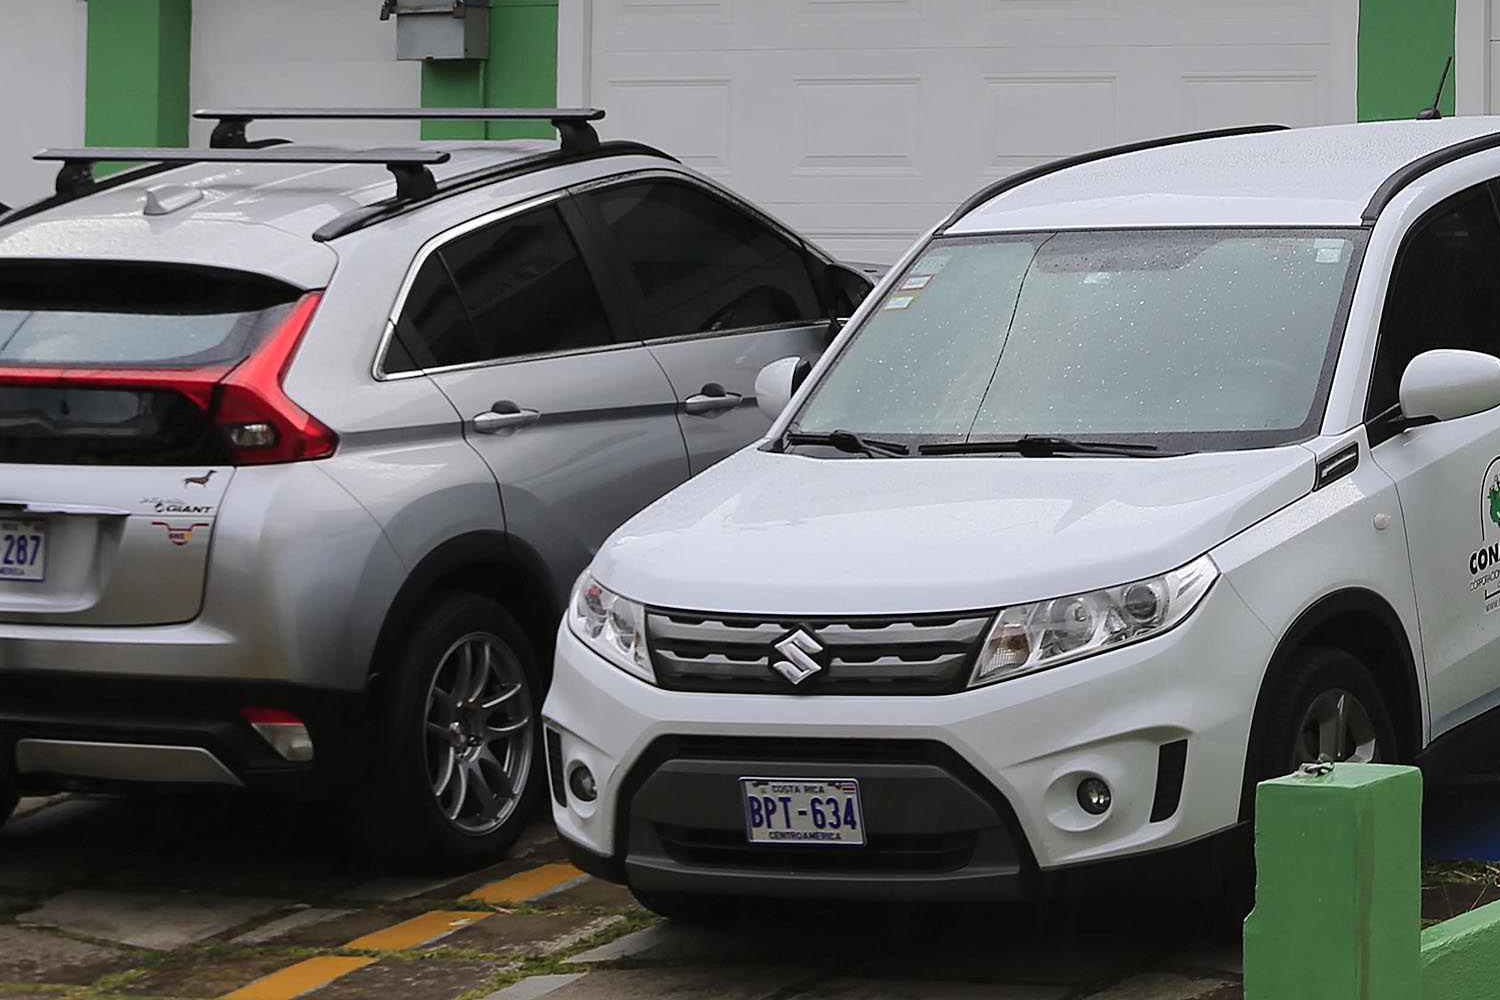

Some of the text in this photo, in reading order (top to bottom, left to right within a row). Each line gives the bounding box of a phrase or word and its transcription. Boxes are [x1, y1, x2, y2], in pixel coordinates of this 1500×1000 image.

[772, 785, 825, 794] COSTA RICA
[748, 796, 857, 830] BPT-634
[768, 831, 842, 841] CENTROAMERICA
